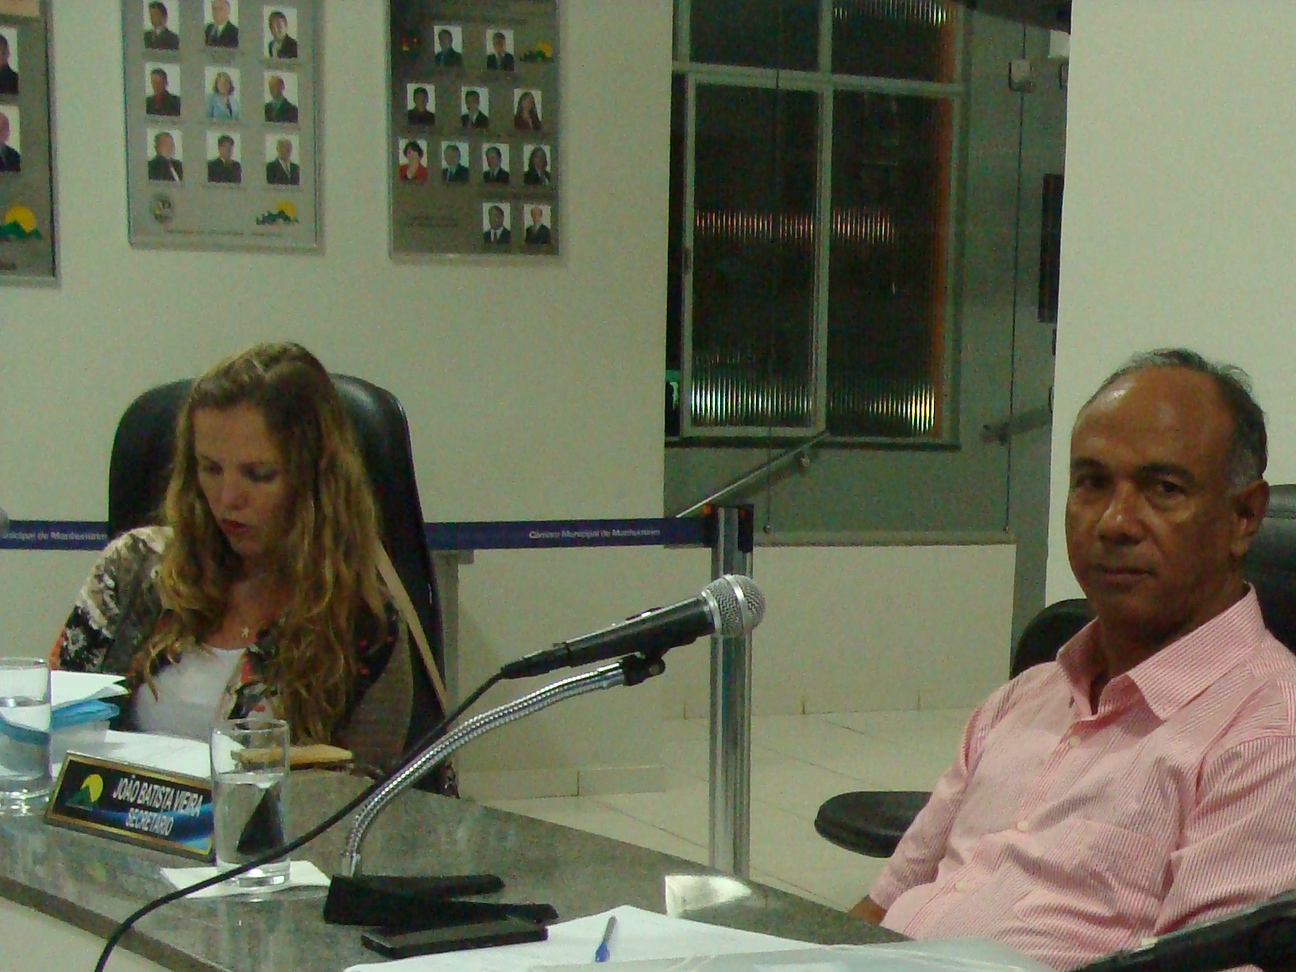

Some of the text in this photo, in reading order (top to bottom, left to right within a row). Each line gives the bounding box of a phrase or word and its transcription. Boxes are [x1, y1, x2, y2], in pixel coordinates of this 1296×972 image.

[113, 774, 203, 818] JOÃO BATISTA VIEIRA
